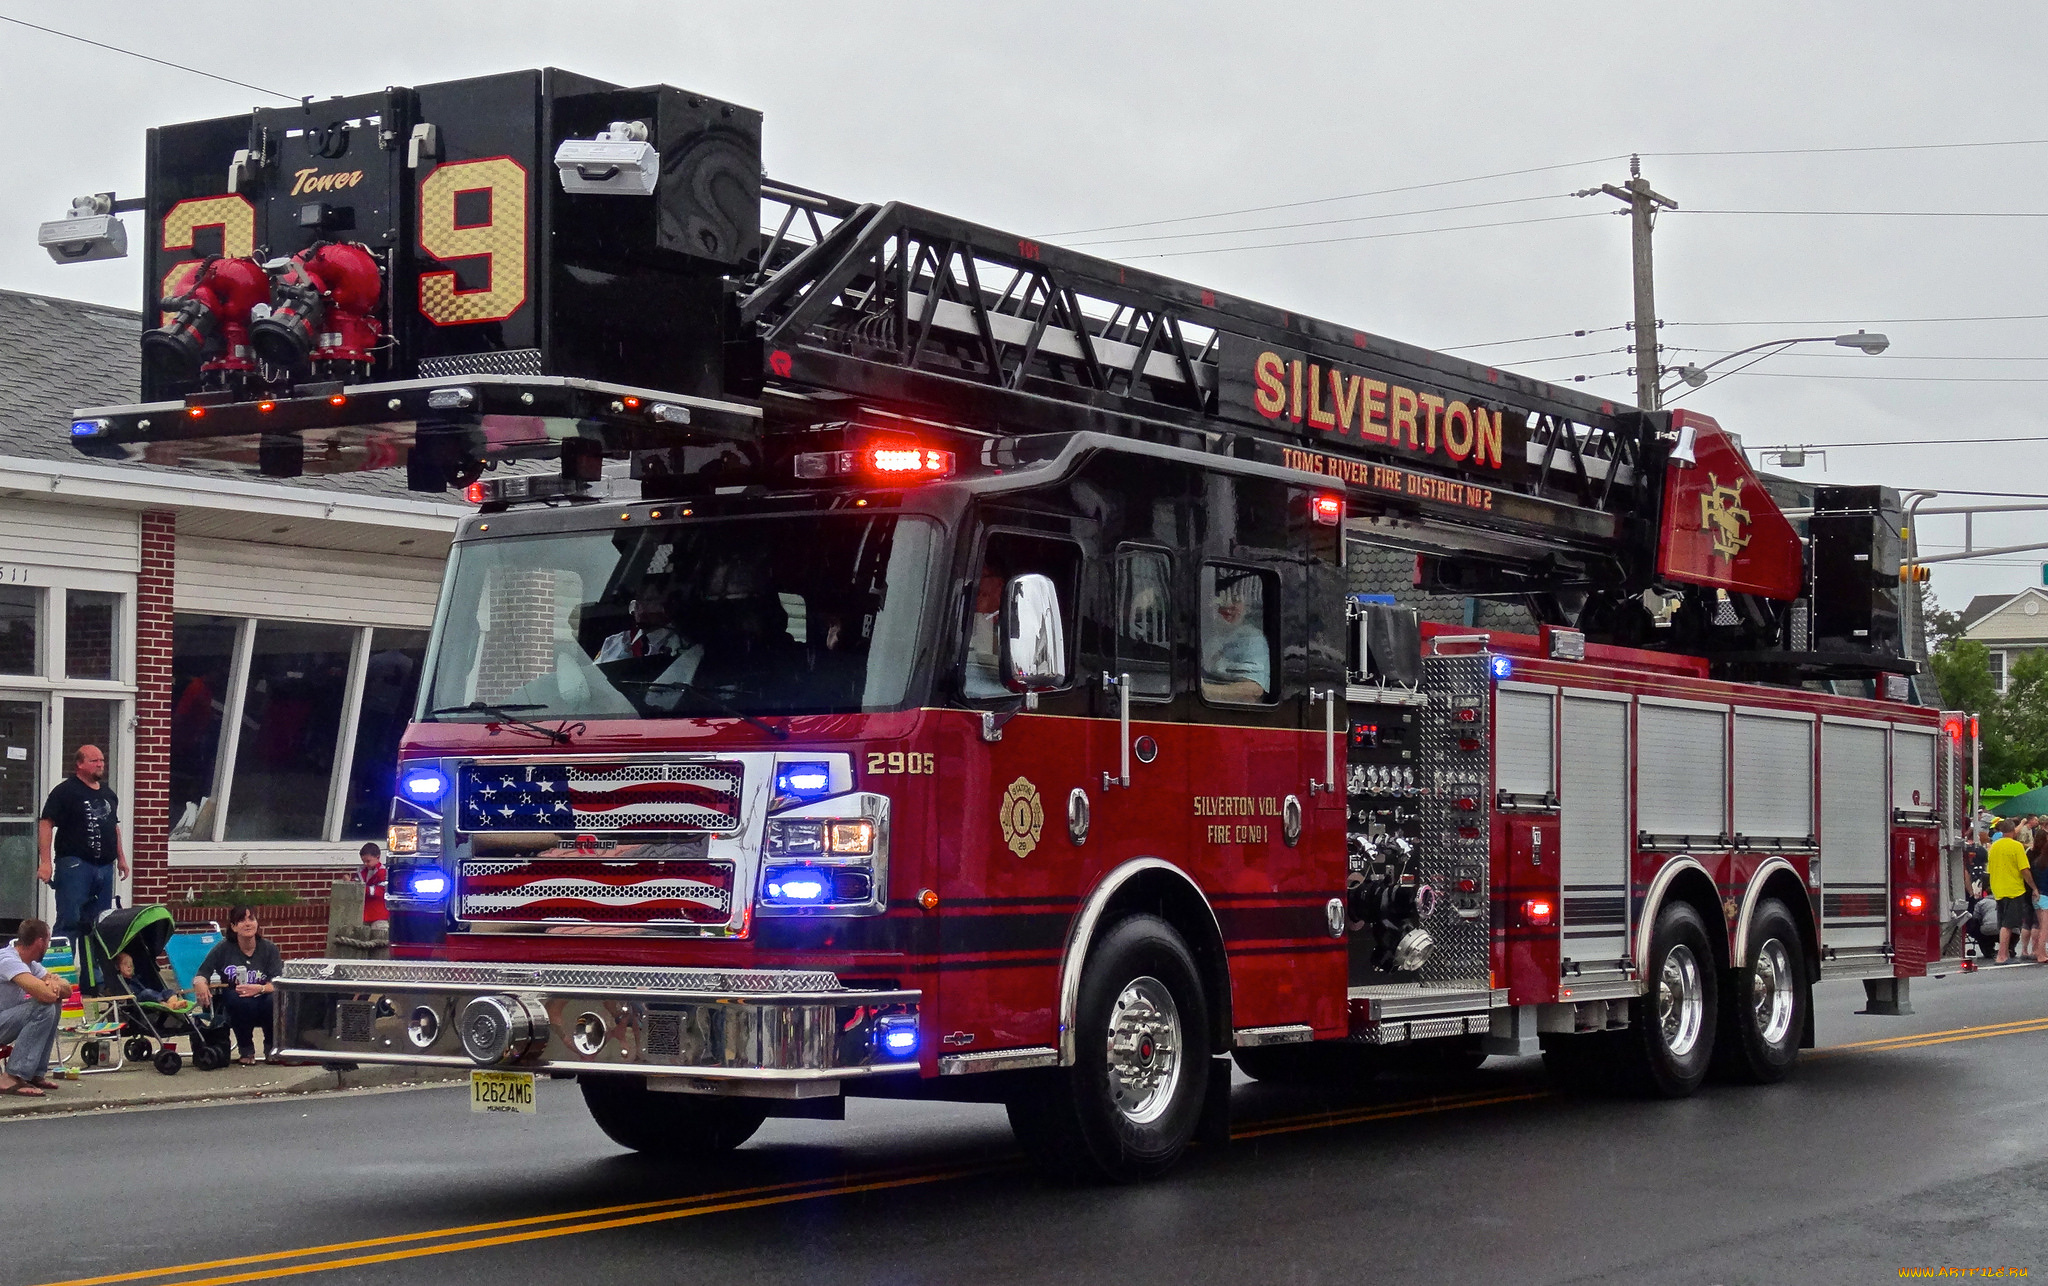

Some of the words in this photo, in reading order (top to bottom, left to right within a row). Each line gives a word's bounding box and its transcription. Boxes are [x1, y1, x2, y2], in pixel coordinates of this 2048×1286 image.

[290, 167, 364, 196] Tower
[1254, 351, 1503, 469] SILVERTON
[1283, 448, 1323, 475] TOMS
[1328, 457, 1368, 486] RIVER
[1374, 466, 1401, 490] FIRE
[1407, 475, 1463, 504] DISTRICT
[867, 752, 935, 775] 2905
[1193, 796, 1255, 816] SILVERTON
[1258, 797, 1282, 816] VOL.
[1019, 808, 1025, 827] 1
[557, 839, 618, 850] rosenbauer
[1207, 825, 1231, 843] FIRE
[475, 1082, 532, 1104] 12624MG
[487, 1105, 519, 1113] MUNICIPAL
